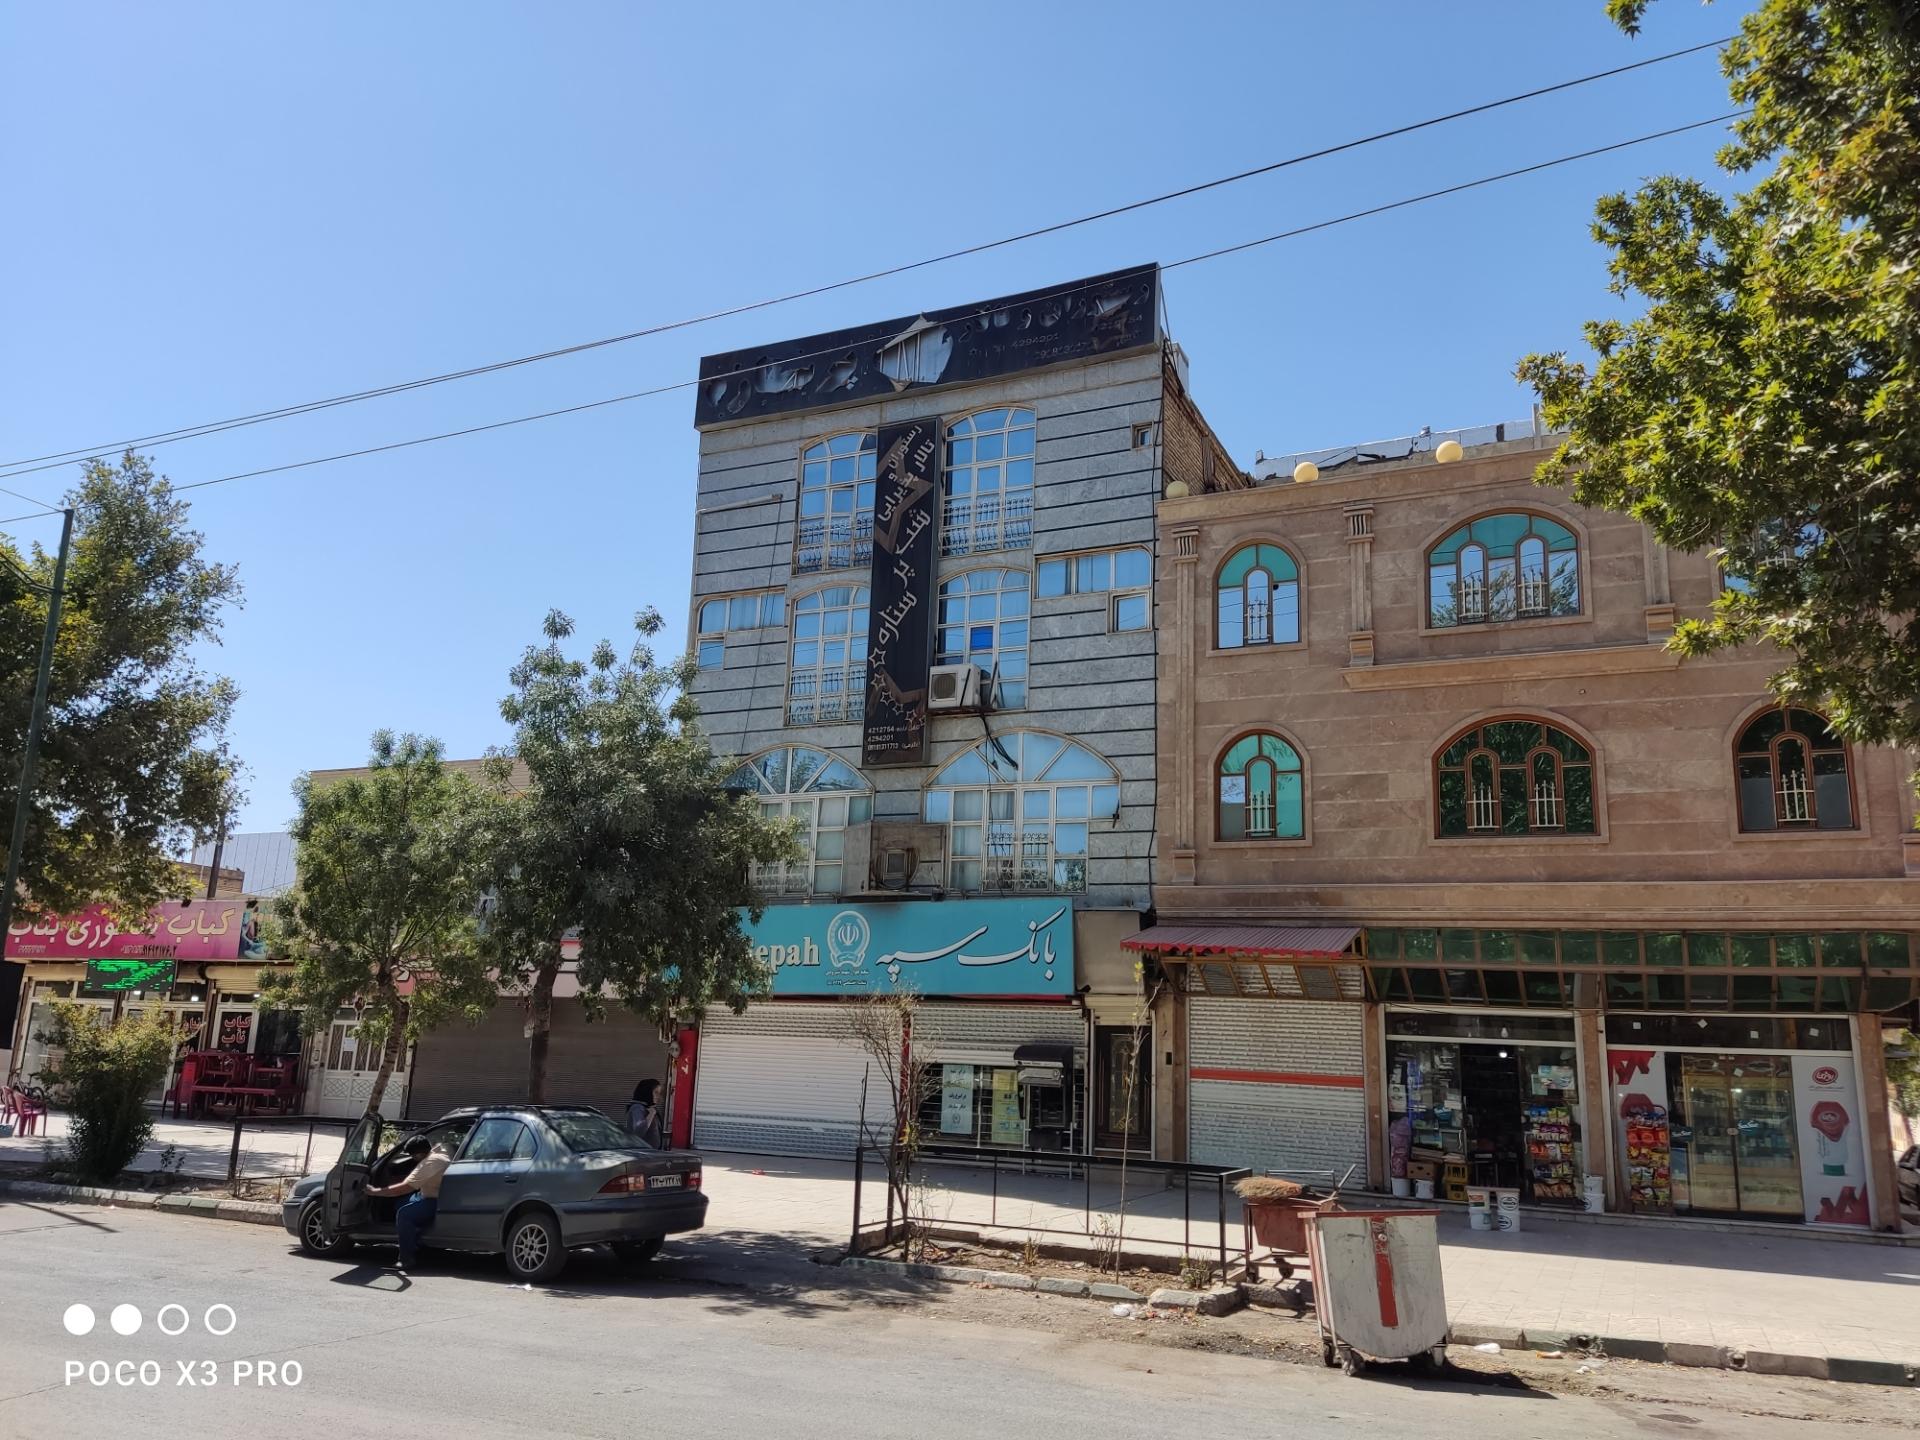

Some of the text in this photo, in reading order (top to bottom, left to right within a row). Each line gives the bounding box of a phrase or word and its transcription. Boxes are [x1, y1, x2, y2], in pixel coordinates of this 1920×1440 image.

[878, 438, 935, 522] تالار پذیرایی
[893, 559, 916, 590] پر
[878, 590, 918, 645] ستاره
[167, 908, 236, 944] کباب
[876, 906, 1066, 983] بانک سپه
[750, 936, 820, 973] epah
